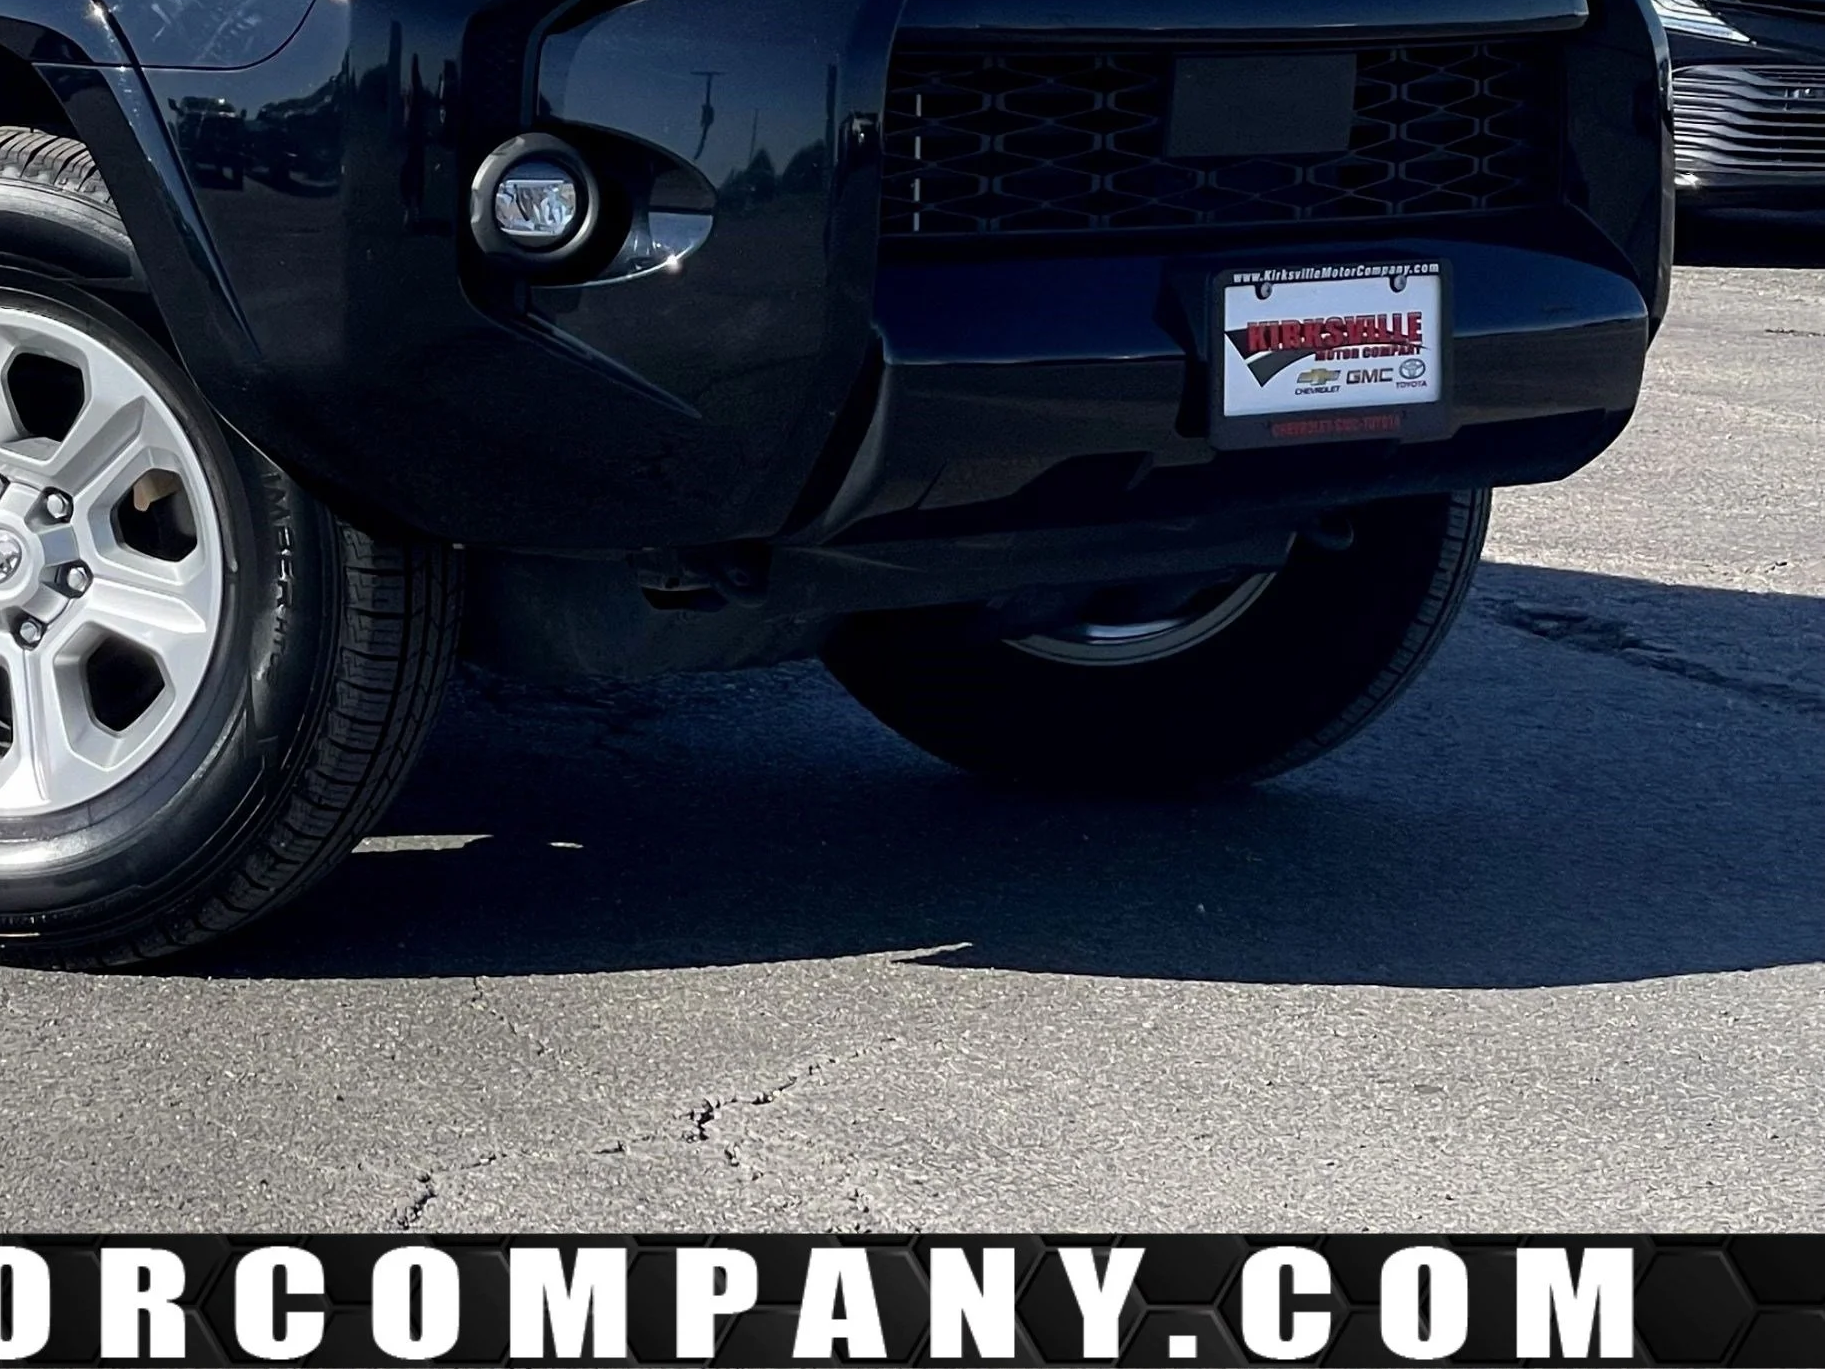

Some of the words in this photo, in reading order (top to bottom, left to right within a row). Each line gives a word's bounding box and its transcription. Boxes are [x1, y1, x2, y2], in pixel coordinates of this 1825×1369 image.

[1233, 263, 1439, 283] www.KirksvilleMotorCompany.com
[1246, 311, 1423, 353] KIRKSVILLE
[1315, 349, 1360, 362] MOTOR
[1346, 367, 1394, 385] GMC
[1294, 385, 1341, 396] CHEVROLET
[1396, 380, 1428, 389] TOYOTA
